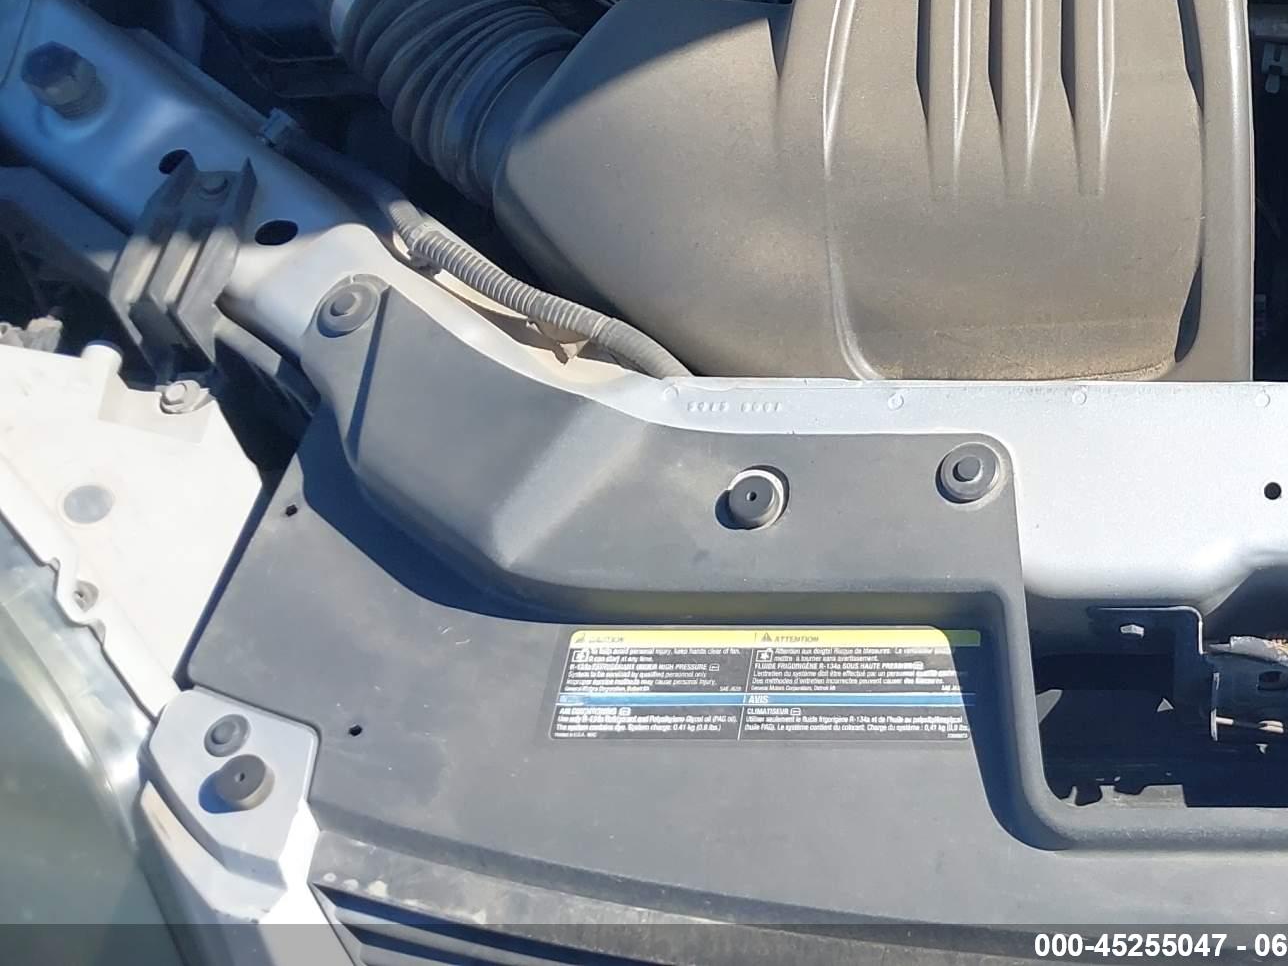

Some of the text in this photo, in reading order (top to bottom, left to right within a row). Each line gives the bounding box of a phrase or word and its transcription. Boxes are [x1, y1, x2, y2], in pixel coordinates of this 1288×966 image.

[842, 662, 859, 670] SOUS
[748, 695, 769, 704] AVIS
[747, 707, 789, 715] CLIMATISEUR
